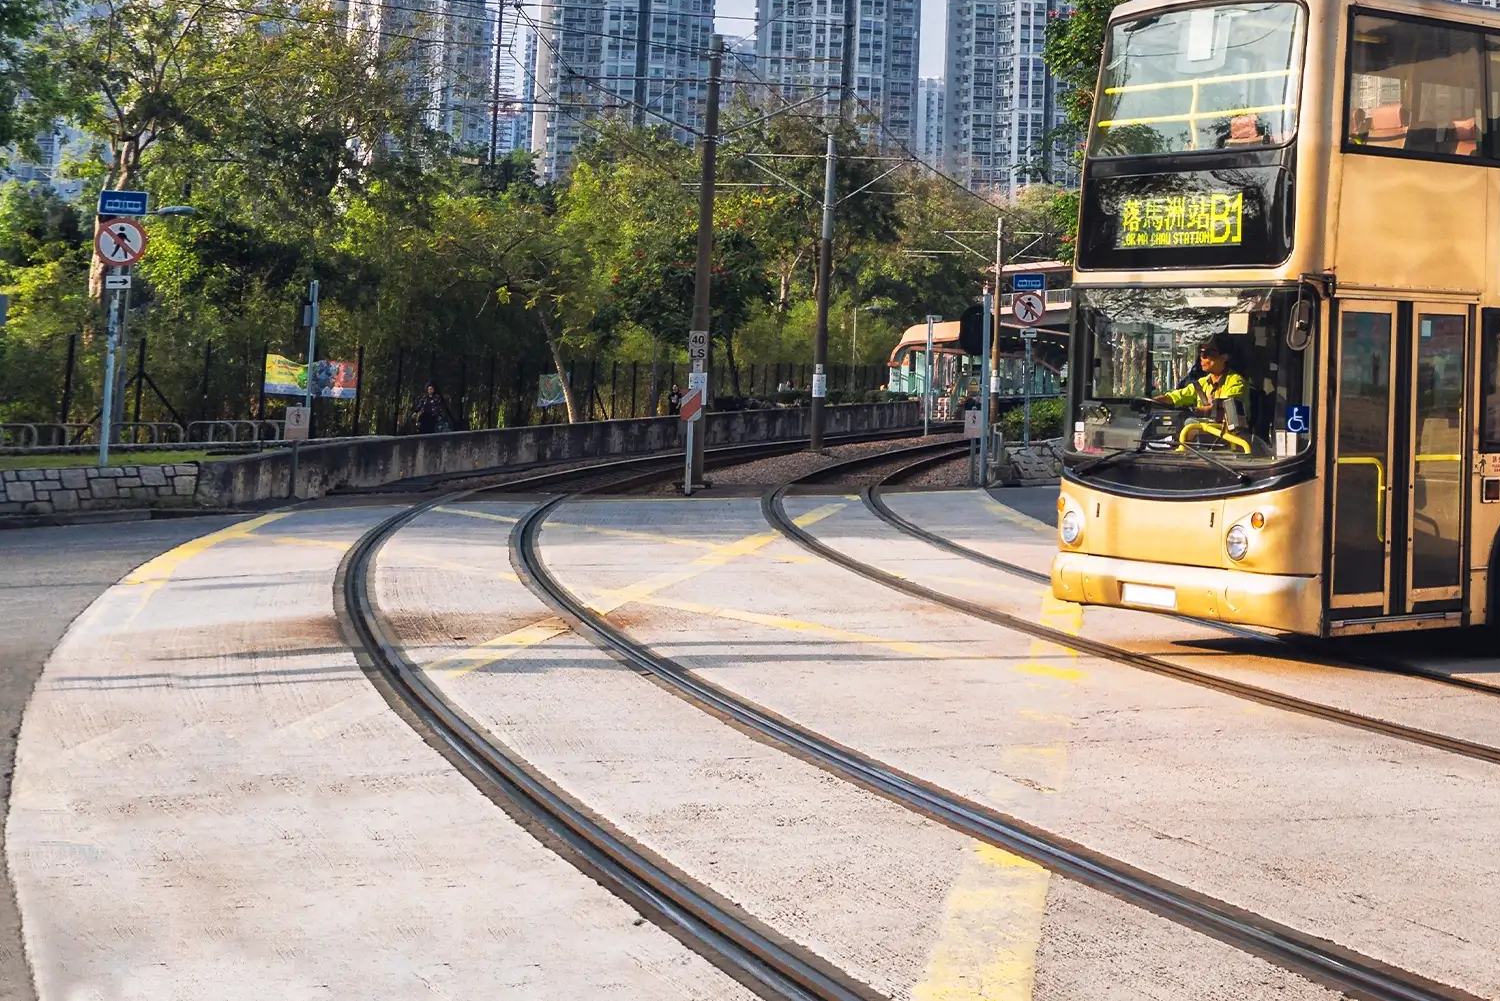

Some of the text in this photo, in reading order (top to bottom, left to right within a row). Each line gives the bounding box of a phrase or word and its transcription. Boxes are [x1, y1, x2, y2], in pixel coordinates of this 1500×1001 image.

[1210, 192, 1243, 243] B1
[1173, 230, 1211, 245] STATION
[691, 335, 705, 345] 40
[690, 348, 705, 358] LS
